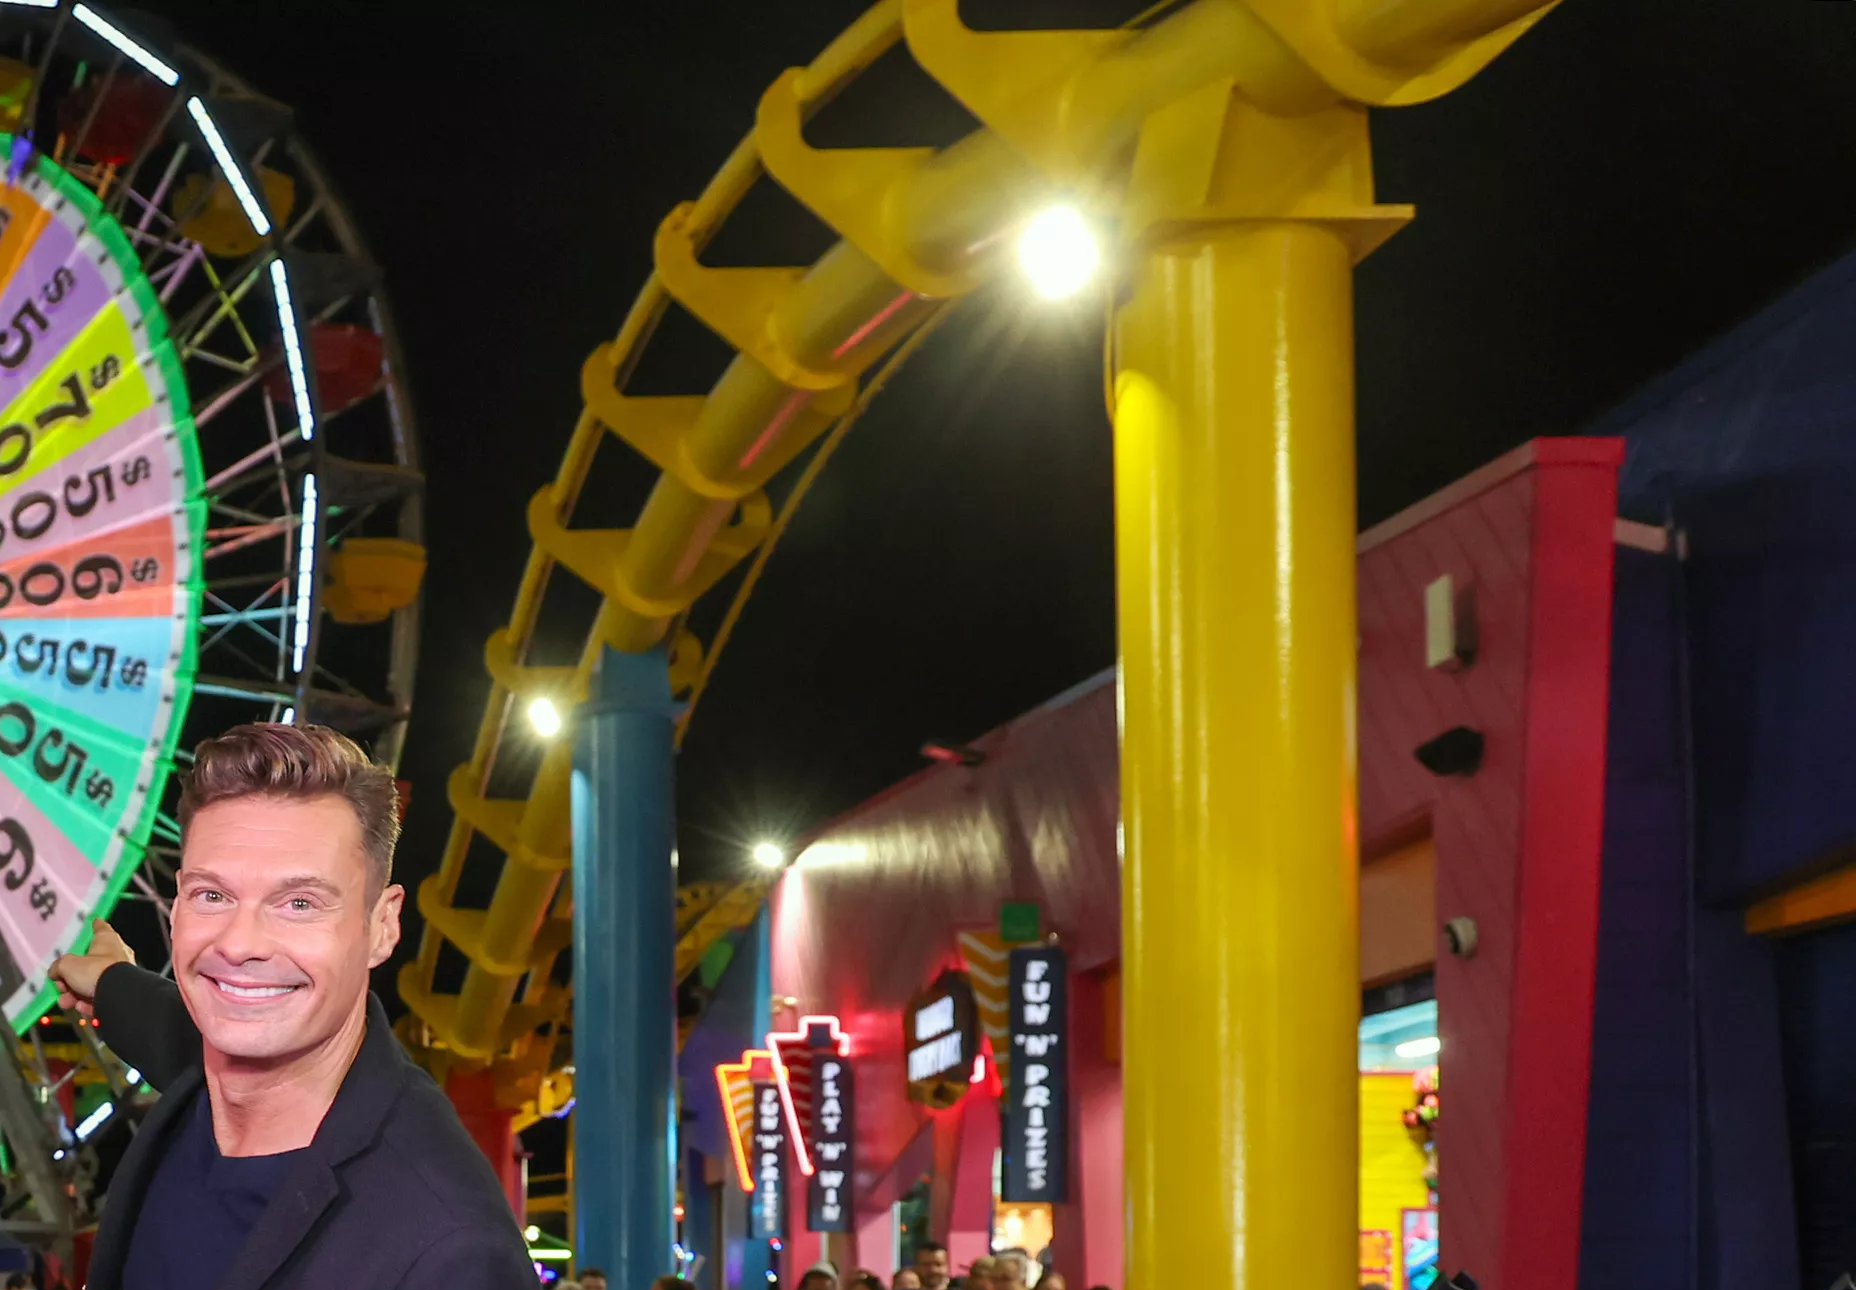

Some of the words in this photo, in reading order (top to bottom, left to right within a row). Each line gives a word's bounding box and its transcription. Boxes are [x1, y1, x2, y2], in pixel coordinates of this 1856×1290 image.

[1022, 960, 1051, 1025] FUN
[820, 1061, 842, 1133] PLAY
[1022, 1064, 1051, 1190] PRIZES
